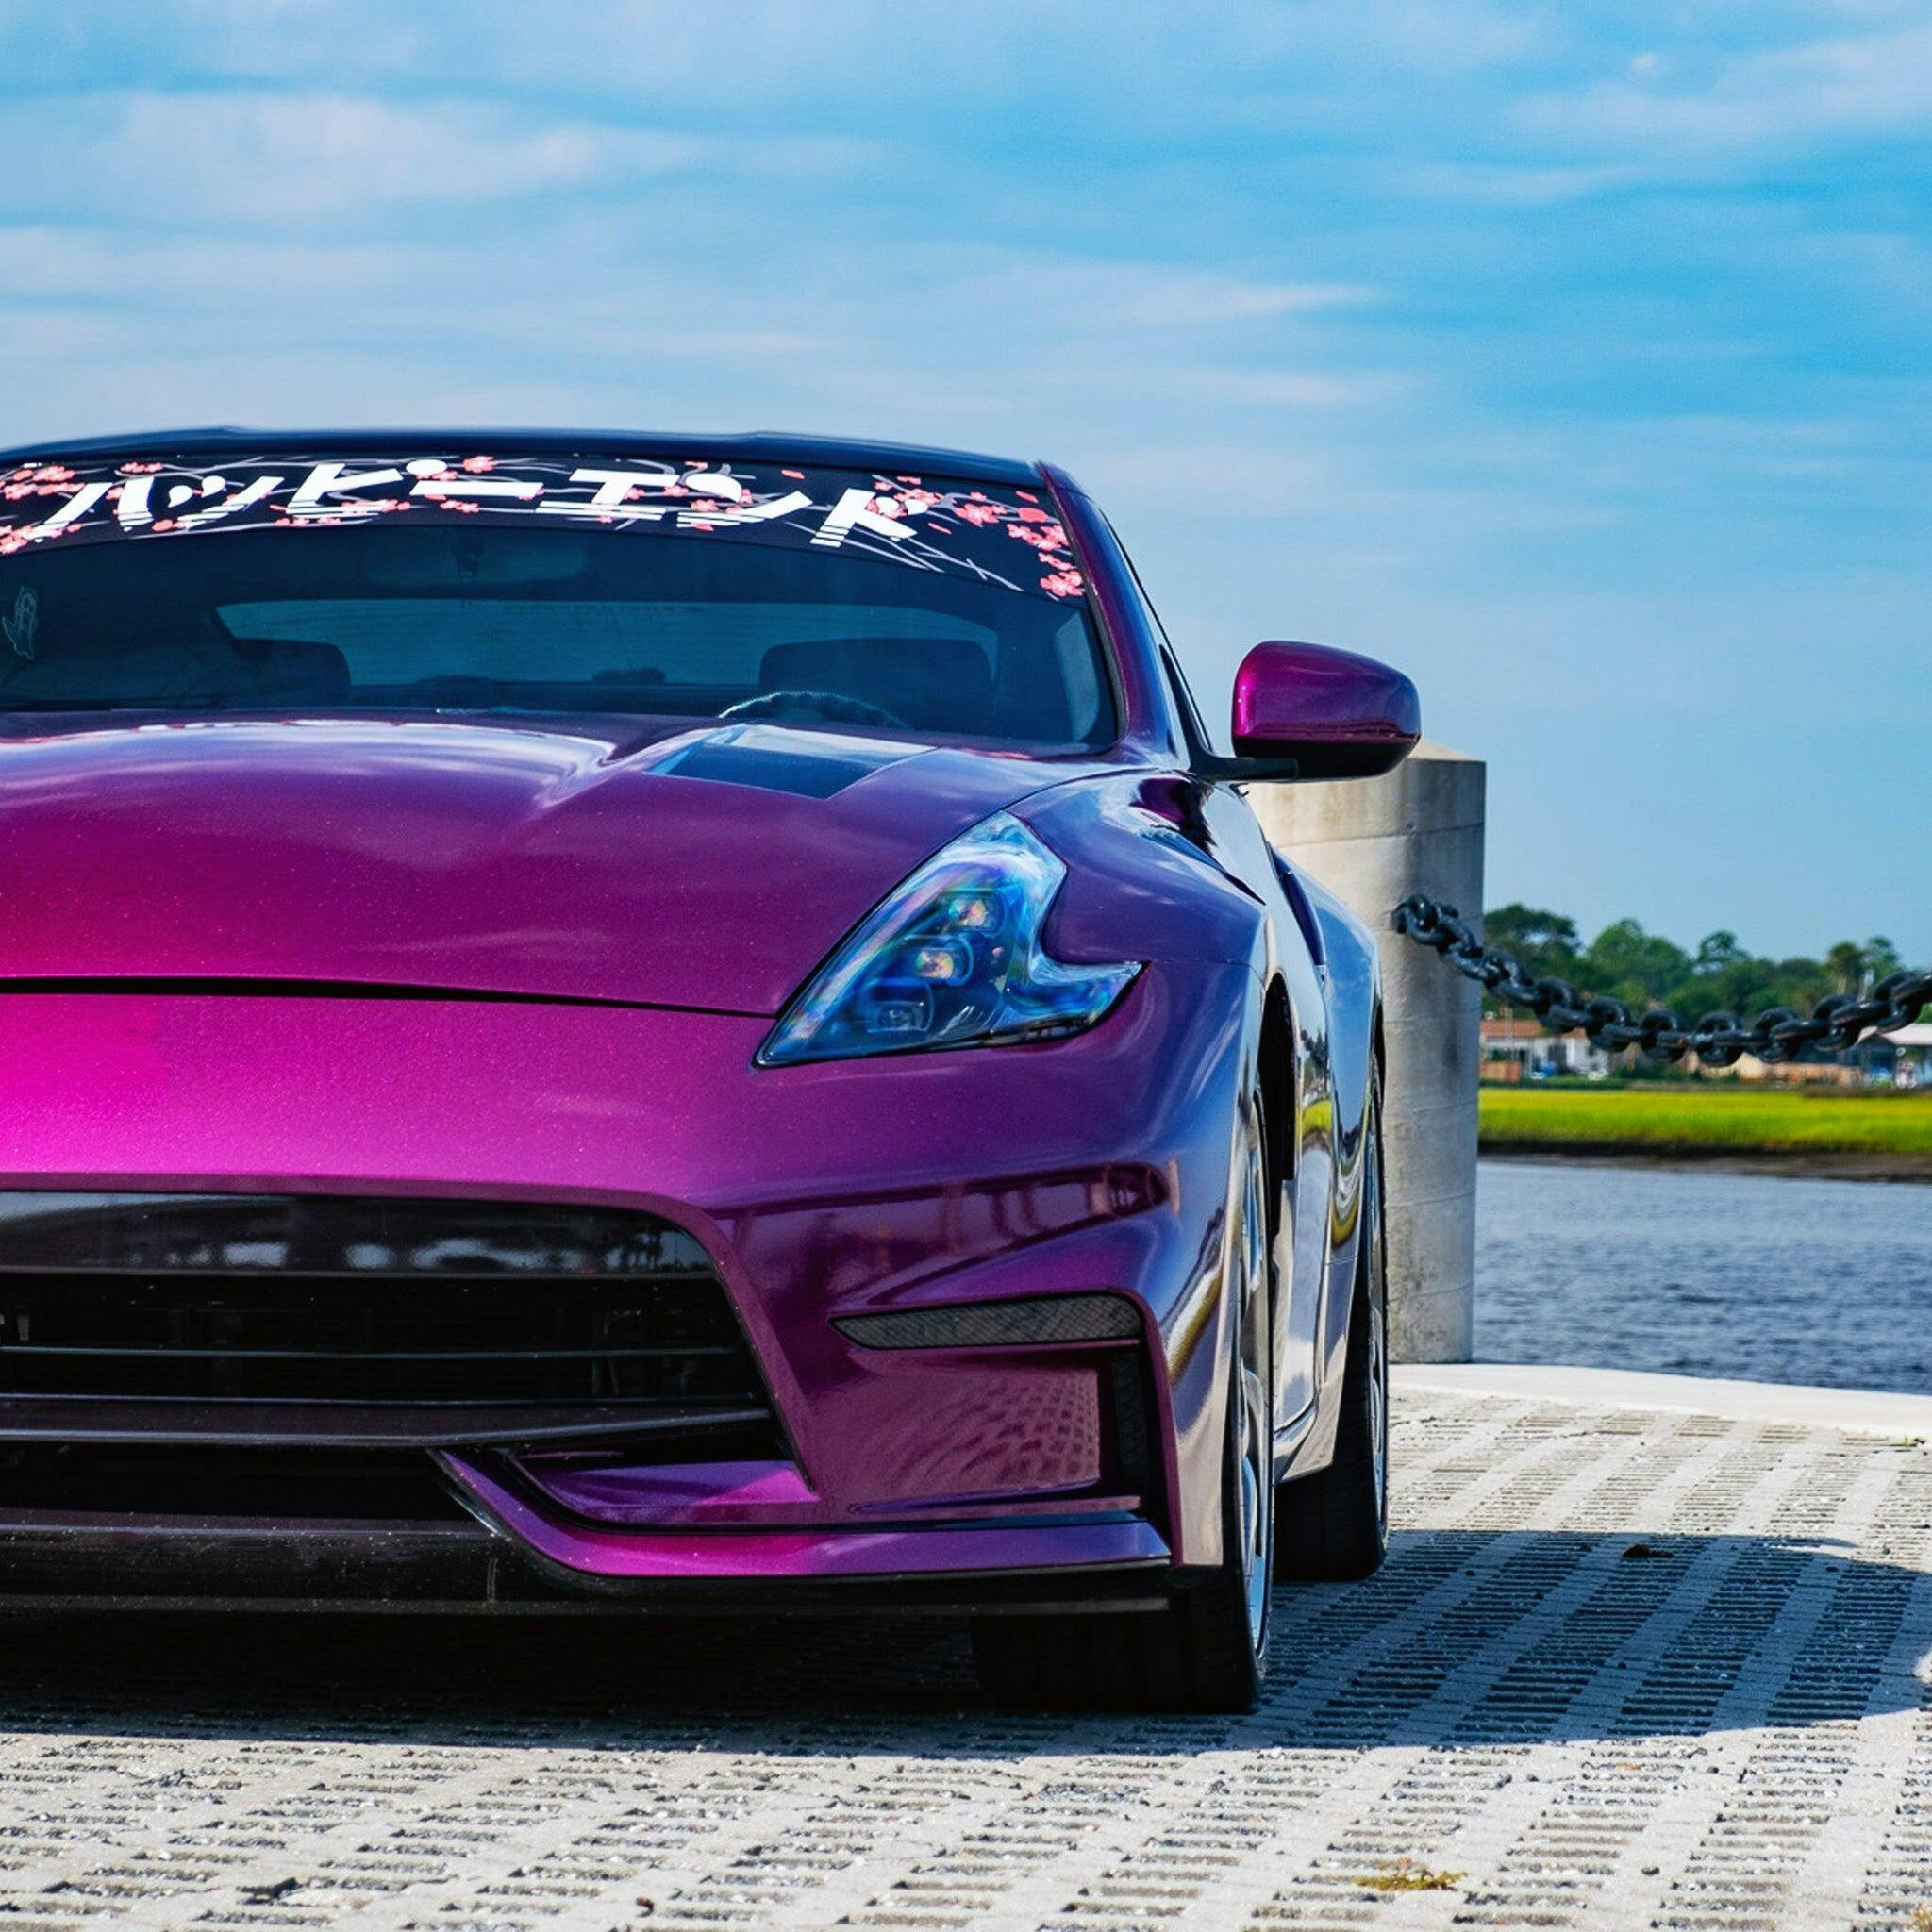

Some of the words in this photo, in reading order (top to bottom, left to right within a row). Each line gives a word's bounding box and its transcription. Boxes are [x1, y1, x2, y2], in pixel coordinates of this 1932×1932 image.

[25, 458, 929, 548] ハッピーエンド
